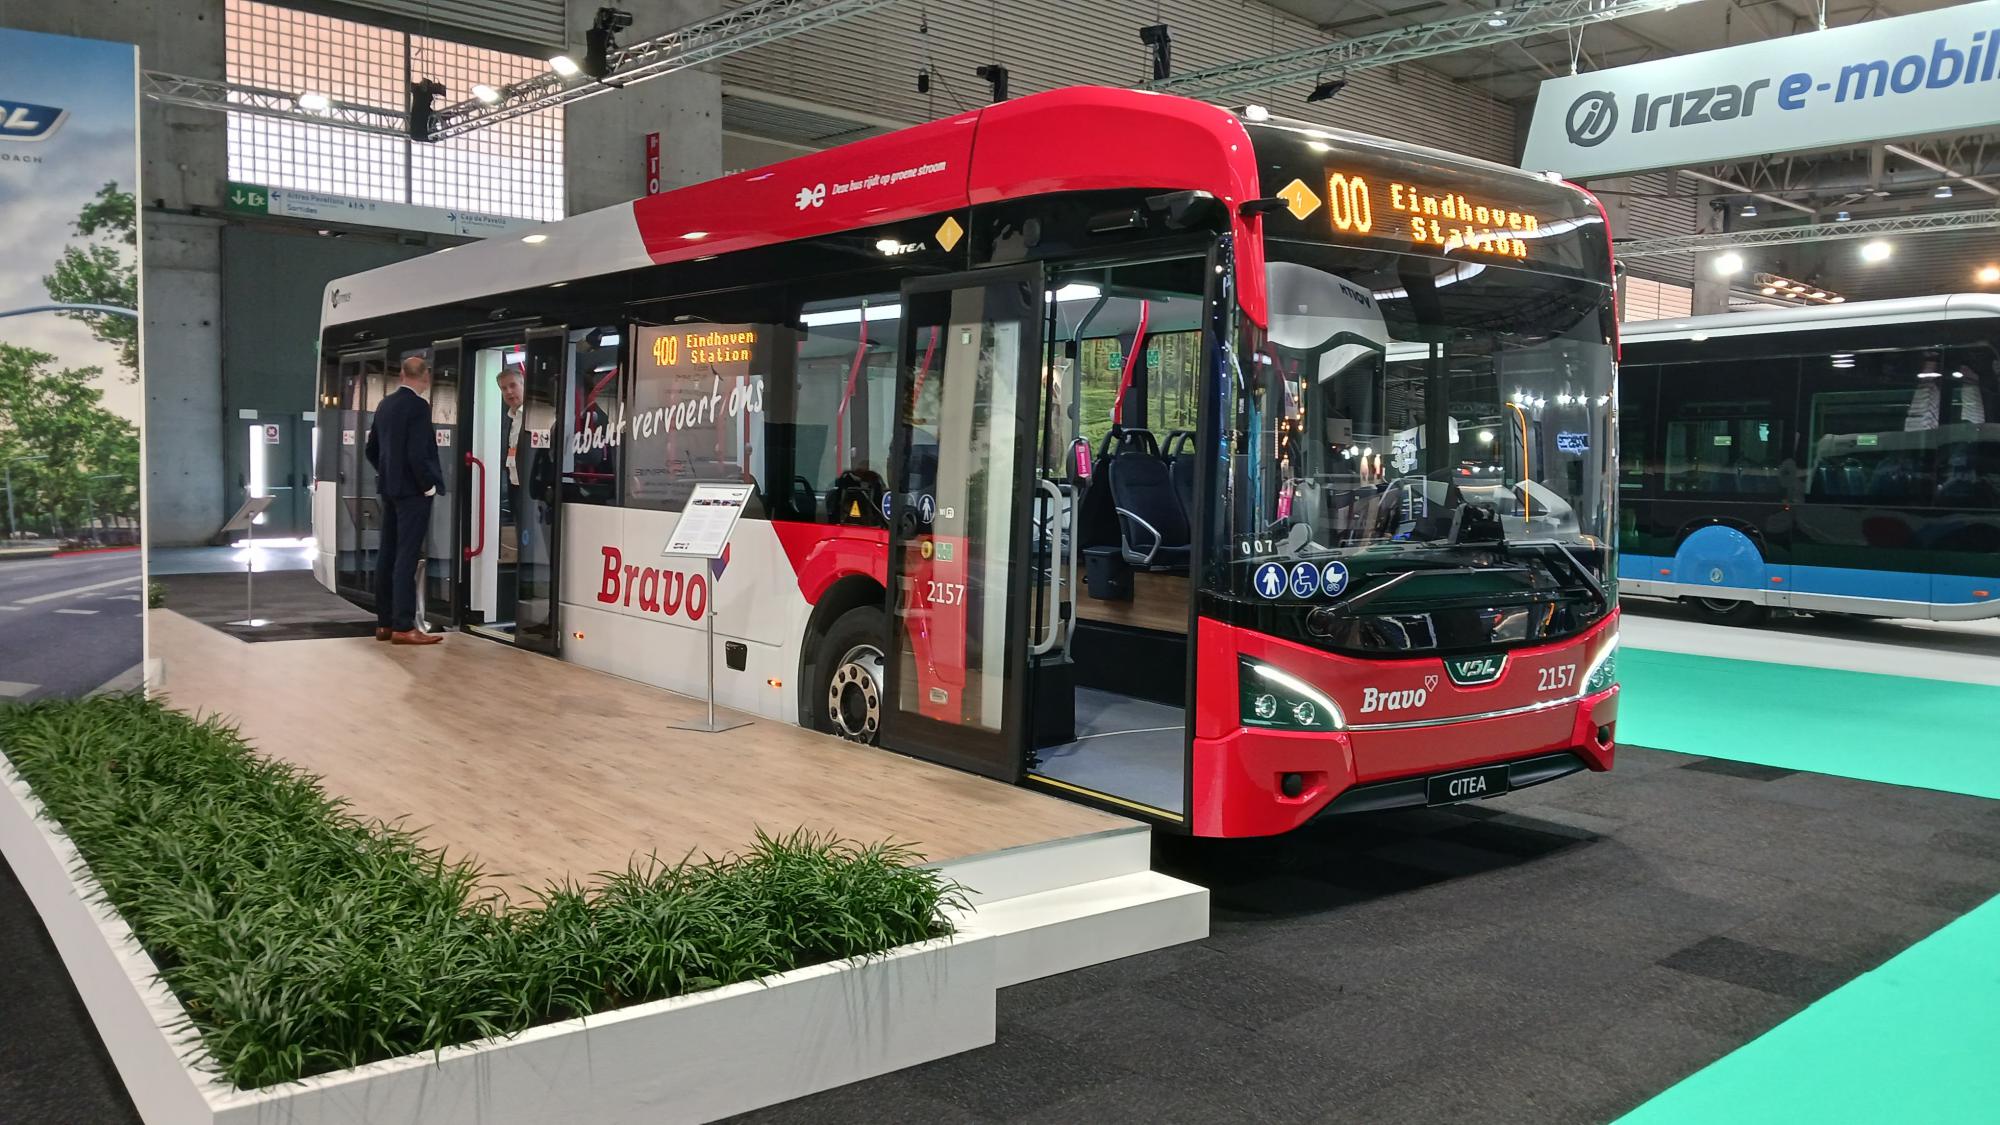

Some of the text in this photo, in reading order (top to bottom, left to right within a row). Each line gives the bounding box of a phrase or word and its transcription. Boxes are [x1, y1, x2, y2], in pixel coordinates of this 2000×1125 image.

[1631, 28, 2000, 133] Irizar e-mobil
[0, 106, 39, 130] L
[831, 161, 946, 195] Deze bus rijdt op groene stroom
[1390, 182, 1539, 232] Eindhoven
[1410, 216, 1528, 257] Station
[653, 336, 679, 366] 400
[686, 332, 755, 348] Eindhoven
[691, 349, 750, 365] Station
[632, 374, 722, 441] vervoert
[728, 379, 765, 417] ons
[597, 546, 707, 622] Bravo
[927, 581, 965, 606] 2157
[1455, 658, 1497, 678] VDL
[1537, 664, 1576, 692] 2157
[1360, 687, 1427, 714] Bravo
[1449, 776, 1487, 797] CITEA
